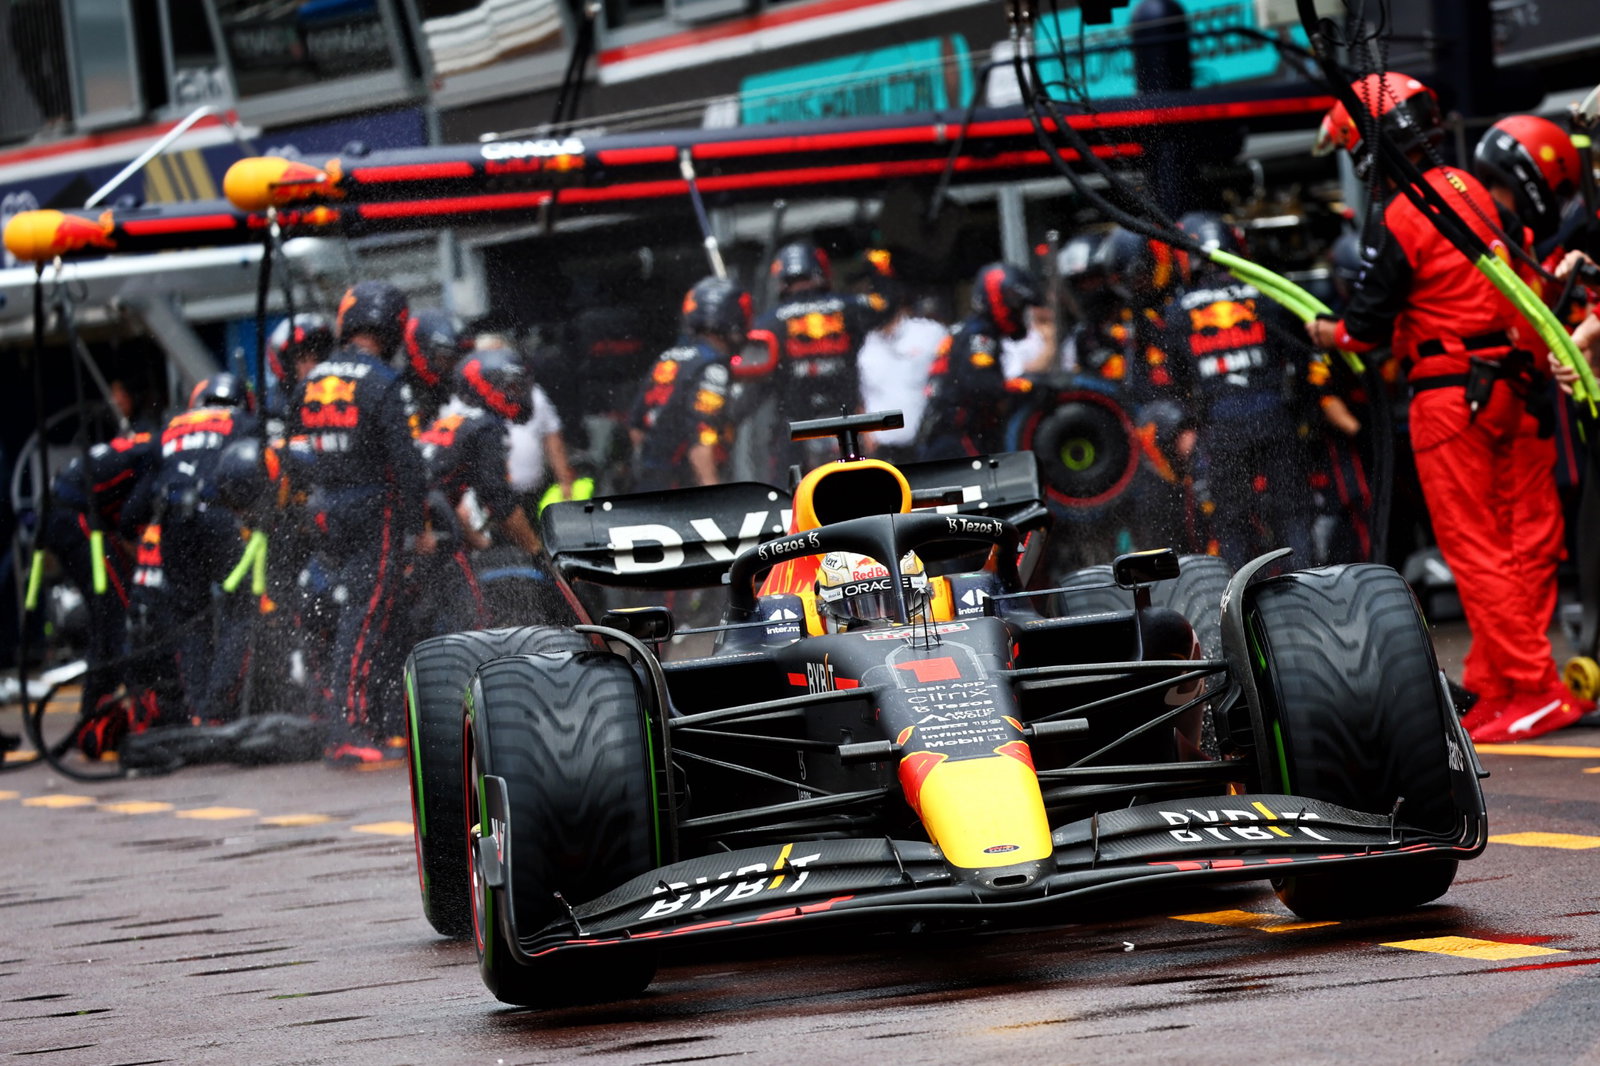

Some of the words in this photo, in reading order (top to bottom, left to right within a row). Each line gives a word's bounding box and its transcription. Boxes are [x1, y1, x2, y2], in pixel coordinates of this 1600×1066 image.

[961, 518, 992, 533] Tezos
[769, 538, 805, 555] Tezos
[853, 570, 874, 581] Red
[844, 577, 910, 597] ORACE
[904, 685, 946, 693] Cash
[951, 681, 985, 690] App
[934, 700, 993, 710] Tezos
[924, 736, 984, 748] Mobil
